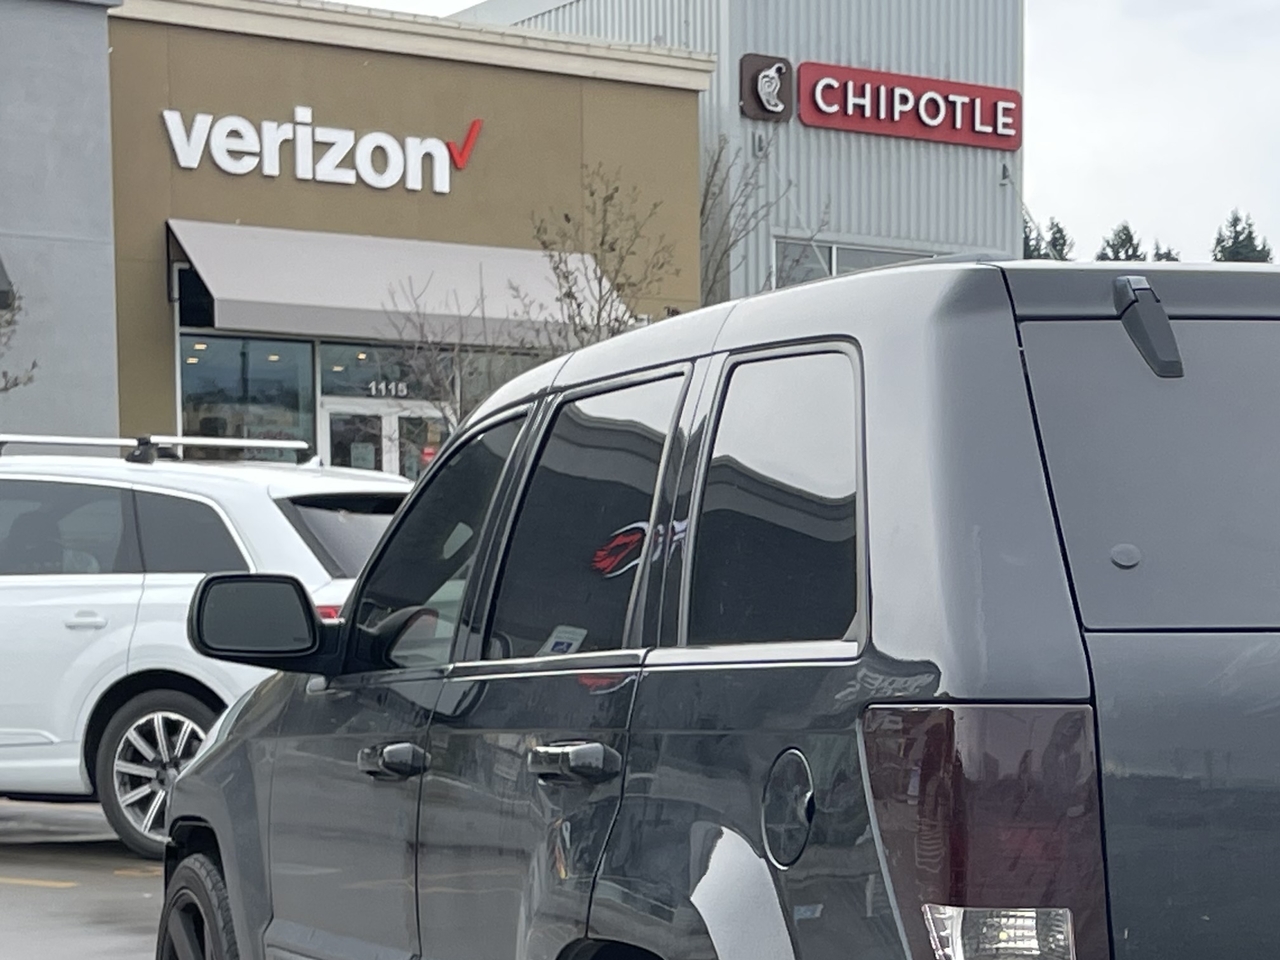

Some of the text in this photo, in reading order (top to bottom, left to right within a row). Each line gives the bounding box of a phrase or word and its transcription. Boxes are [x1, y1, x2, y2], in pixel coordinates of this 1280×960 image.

[814, 77, 1016, 136] CHIPOTLE
[162, 105, 450, 193] verizon
[368, 380, 408, 397] 1115
